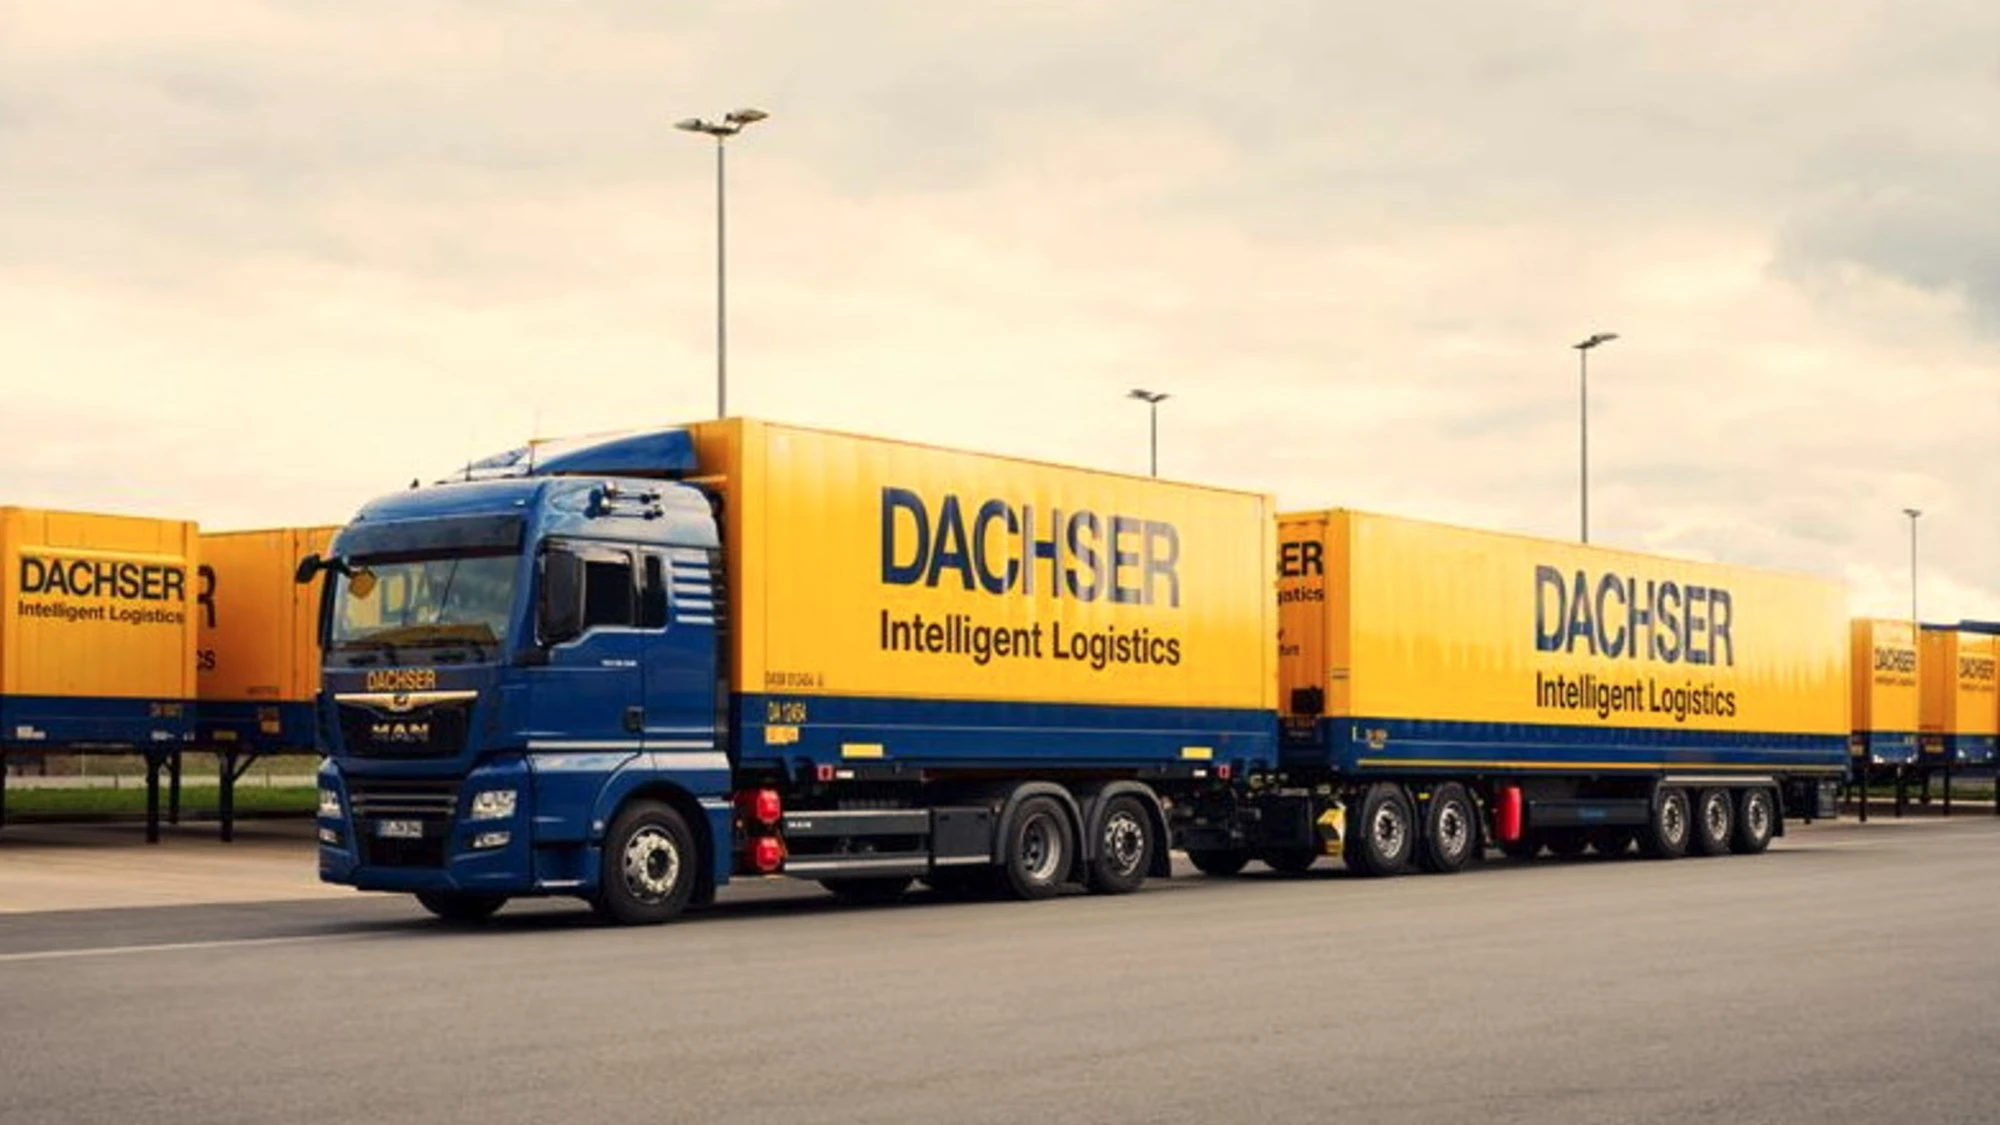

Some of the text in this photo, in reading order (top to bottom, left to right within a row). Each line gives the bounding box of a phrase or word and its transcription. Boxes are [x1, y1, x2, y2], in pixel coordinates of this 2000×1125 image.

[881, 486, 1181, 607] DACHSER
[20, 556, 184, 602] DACHSER
[18, 600, 185, 626] Intelligent Logistics
[1536, 565, 1735, 666] DACHSER
[880, 609, 1181, 670] Intelligent Logistics
[367, 669, 436, 692] DACHSER
[1536, 671, 1736, 720] Intelligent Logistics
[372, 723, 429, 742] MAN
